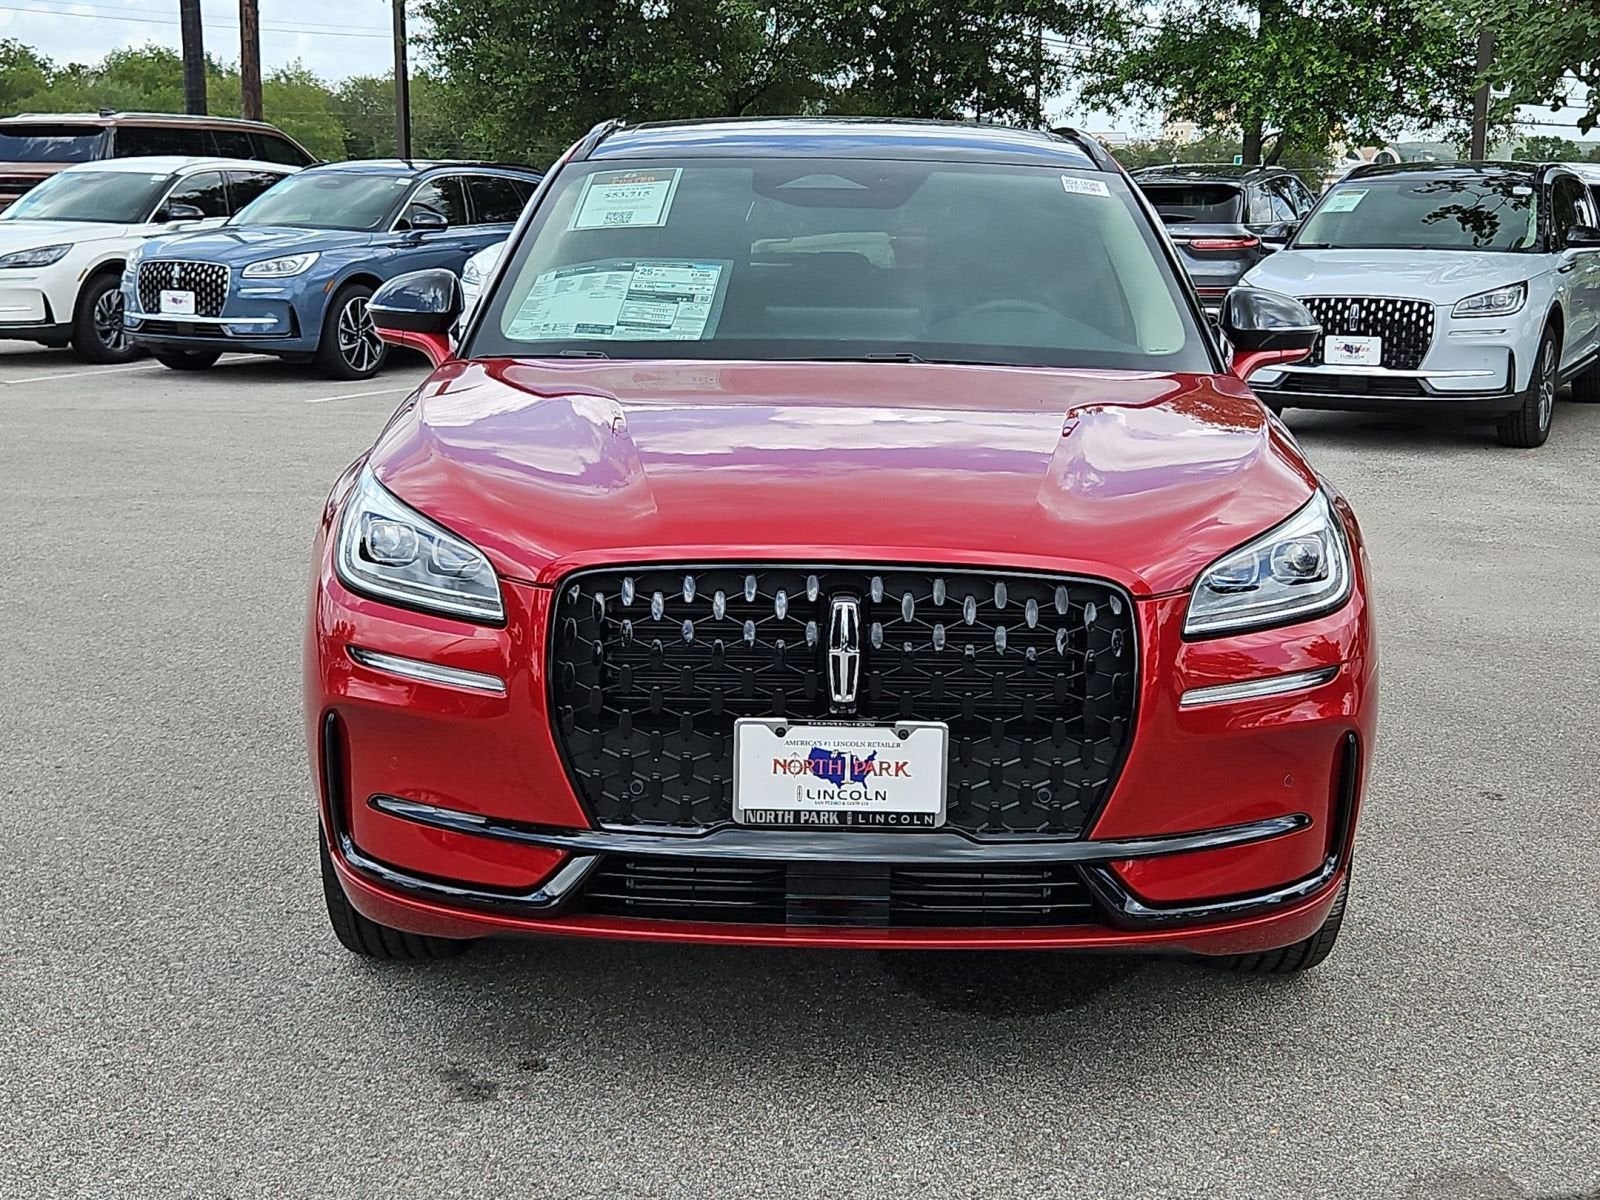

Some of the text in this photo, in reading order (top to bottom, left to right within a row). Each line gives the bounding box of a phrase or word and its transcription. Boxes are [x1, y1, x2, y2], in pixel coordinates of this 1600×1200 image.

[867, 741, 902, 749] RETAILER
[772, 758, 912, 777] NORTH PARK
[806, 789, 887, 801] LINCOLN
[746, 810, 933, 825] NORTH PARK LINCOLN
